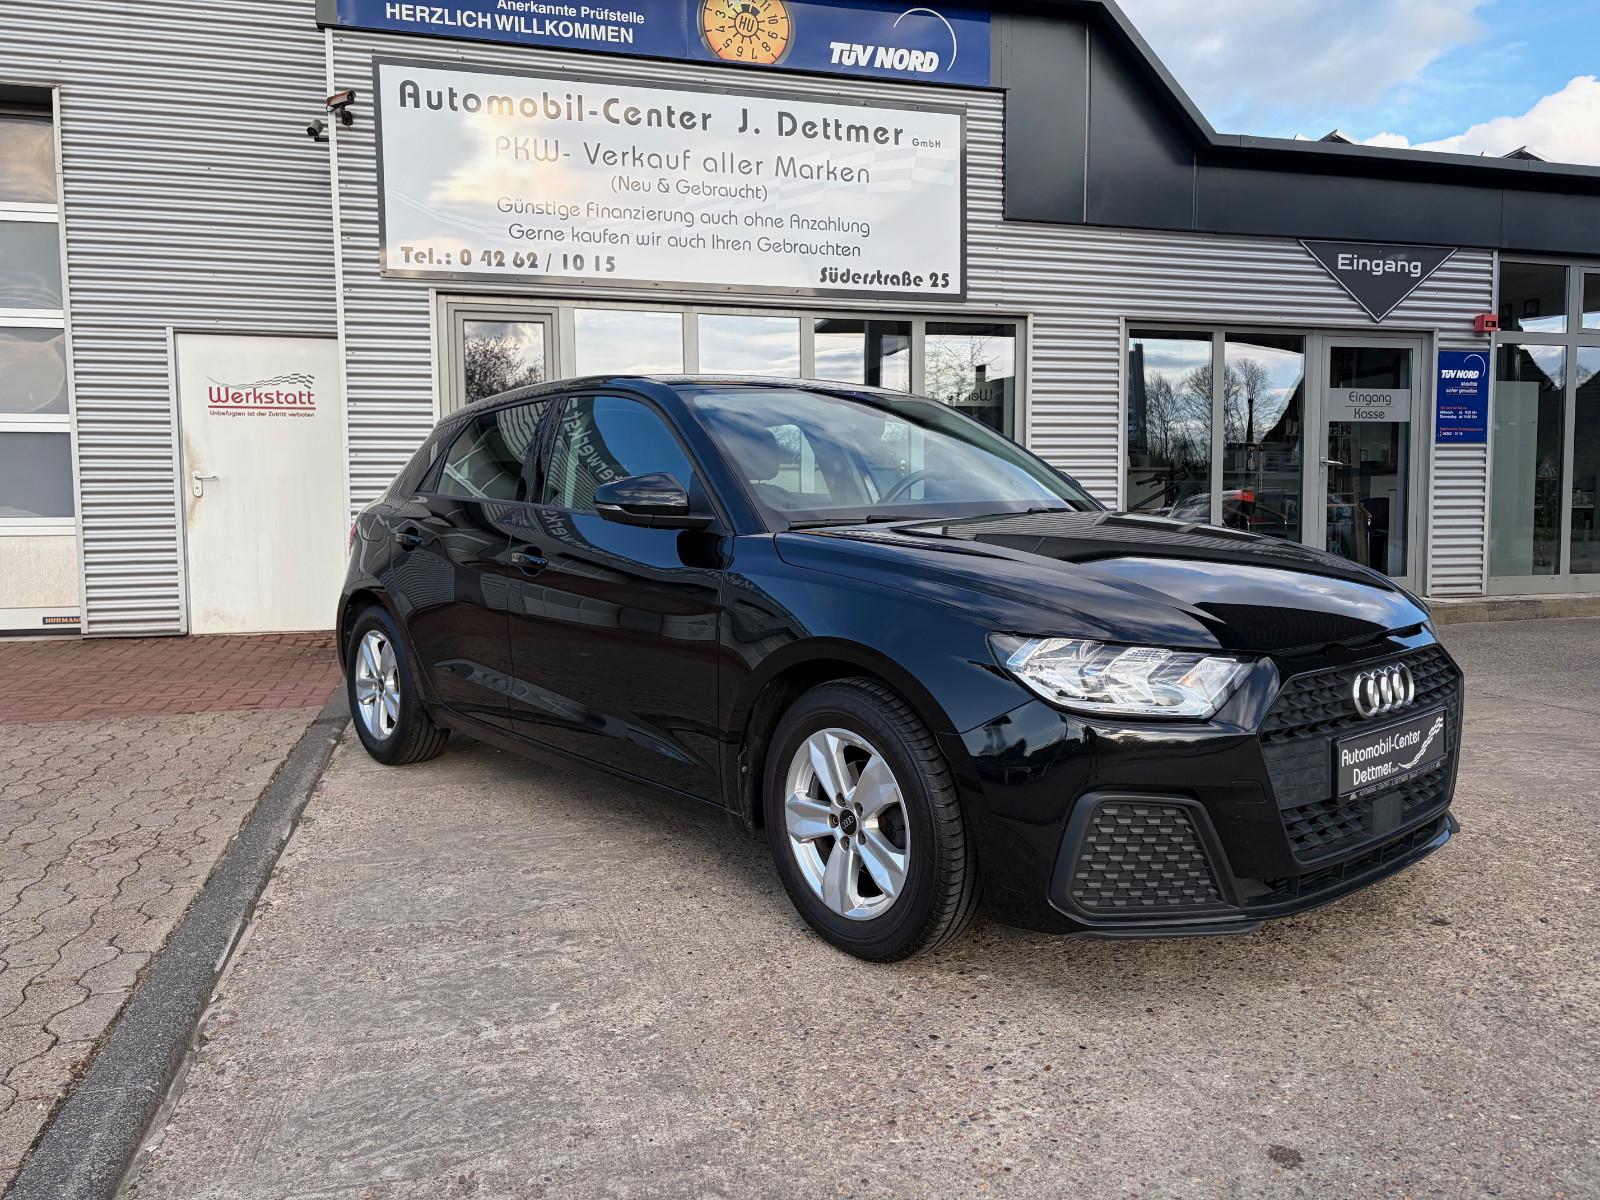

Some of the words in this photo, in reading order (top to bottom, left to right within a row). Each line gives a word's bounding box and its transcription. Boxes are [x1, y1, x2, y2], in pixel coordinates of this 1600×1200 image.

[386, 3, 492, 30] HERZLICH
[495, 14, 633, 43] WILLKOMMEN
[497, 0, 577, 17] Anerkannte
[580, 6, 645, 24] Prüfstelle
[738, 15, 755, 32] HU
[829, 41, 875, 67] TÜV
[874, 48, 939, 73] NORD
[399, 80, 712, 131] Automobil-Center
[738, 108, 760, 134] J.
[777, 111, 904, 145] Dettmer
[912, 138, 941, 148] GmbH
[495, 135, 571, 163] PKW-
[583, 142, 691, 170] Verkauf
[703, 151, 763, 176] aller
[775, 155, 870, 183] Marken
[611, 175, 651, 194] (Neu
[657, 178, 670, 193] &
[676, 180, 768, 202] Gebraucht)
[497, 196, 580, 221] Günstige
[586, 202, 694, 228] Finanzierung
[700, 208, 738, 226] auch
[744, 212, 784, 229] ohne
[789, 214, 870, 237] Anzahlung
[508, 223, 565, 242] Gerne
[571, 226, 629, 245] kaufen
[636, 232, 662, 246] wir
[667, 233, 706, 249] auch
[712, 234, 751, 251] Ihren
[757, 237, 861, 257] Gebrauchten
[400, 247, 452, 265] Tel.:
[459, 249, 472, 266] 0
[512, 251, 538, 268] 62
[562, 253, 585, 271] 10
[595, 255, 616, 272] 15
[1337, 253, 1422, 277] Eingang
[820, 267, 923, 287] Süderstraße
[929, 272, 950, 288] 25
[1441, 370, 1457, 379] TÜV
[1456, 370, 1479, 379] NORD
[208, 386, 315, 405] Werkstatt
[1348, 391, 1392, 406] Eingang
[1354, 408, 1385, 419] Kasse
[1342, 730, 1420, 767] Automobil-Center
[1353, 762, 1392, 785] Dettmer
